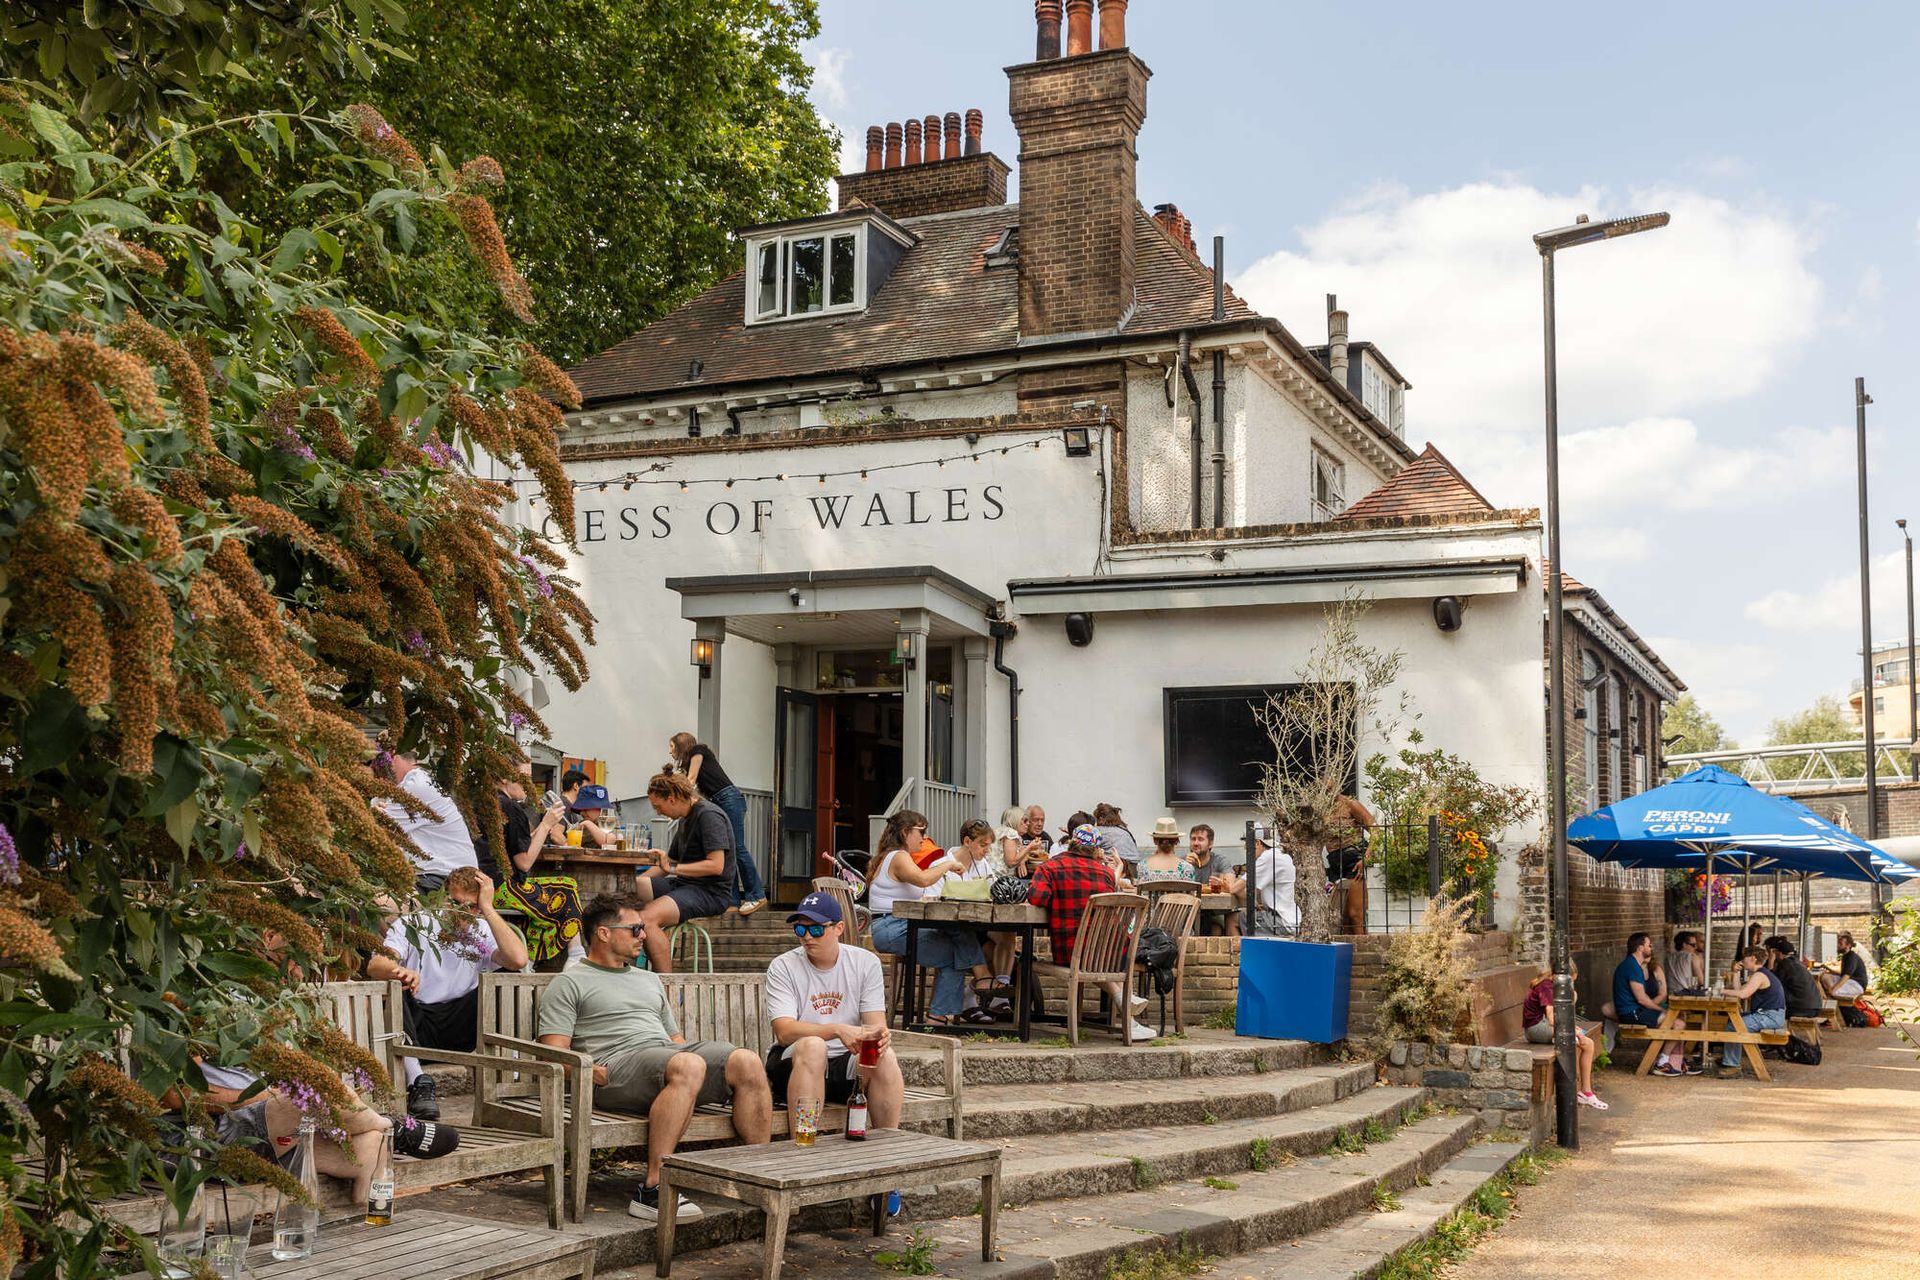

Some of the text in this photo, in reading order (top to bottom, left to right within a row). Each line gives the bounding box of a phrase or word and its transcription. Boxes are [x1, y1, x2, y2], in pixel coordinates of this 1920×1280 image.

[706, 500, 773, 535] OF
[806, 485, 1004, 529] WALES
[1644, 810, 1731, 822] PERONI
[1648, 824, 1716, 834] CAPRI
